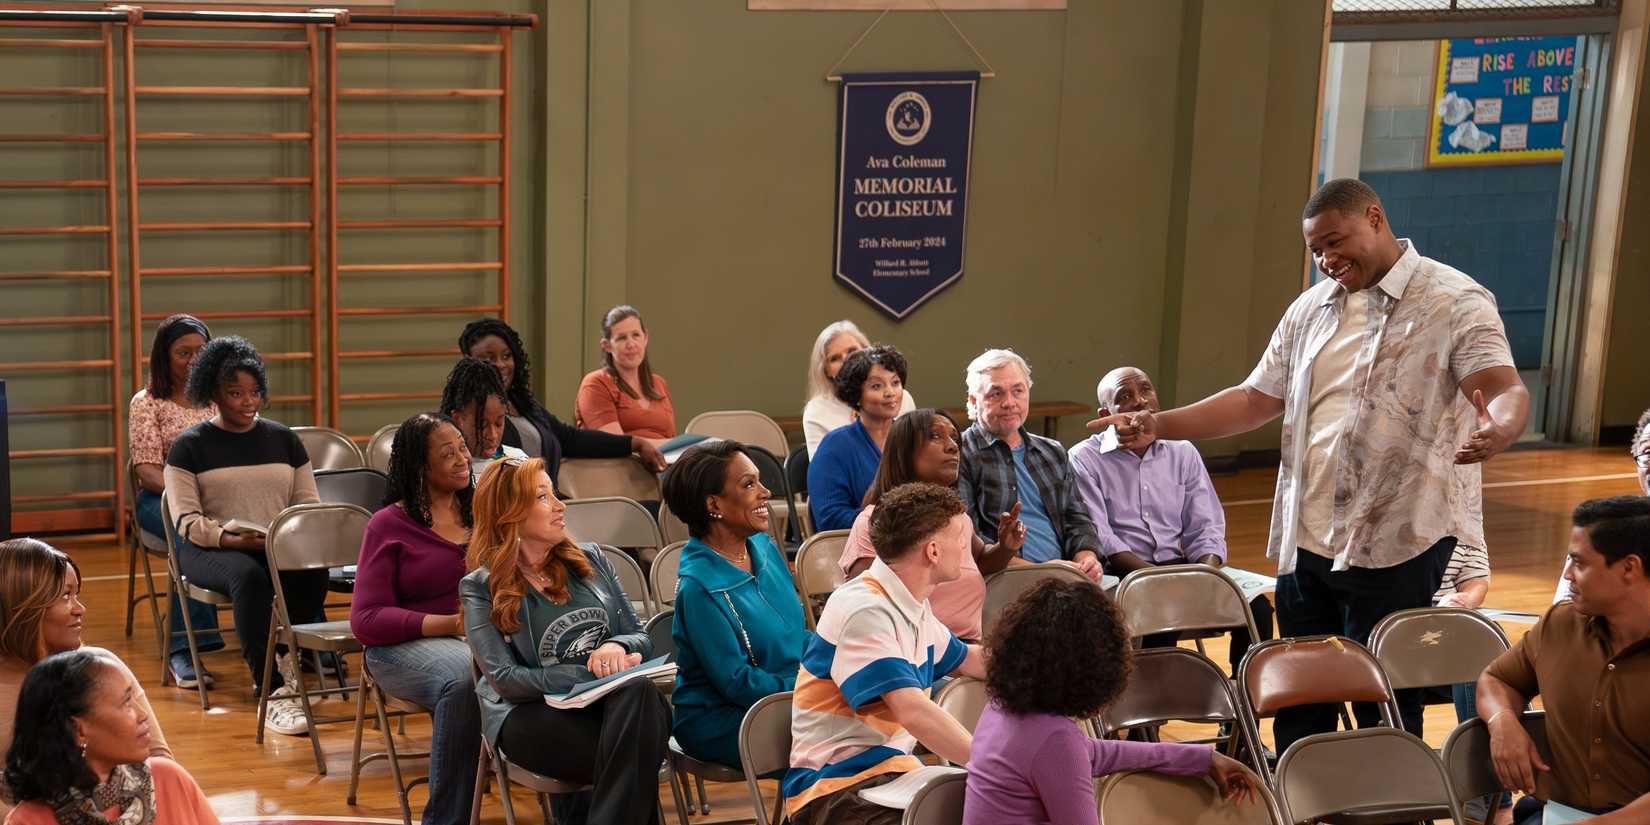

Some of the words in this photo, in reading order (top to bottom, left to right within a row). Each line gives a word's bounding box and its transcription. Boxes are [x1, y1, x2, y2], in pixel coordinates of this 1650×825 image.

[1482, 52, 1515, 72] RISE
[1526, 47, 1574, 68] ABOVE
[1503, 76, 1531, 96] THE
[866, 155, 889, 168] Ava
[892, 154, 946, 168] Coleman
[853, 177, 957, 194] MEMORIAL
[855, 200, 953, 218] COLISEUM
[858, 238, 879, 248] 27th
[880, 237, 922, 250] February
[923, 236, 946, 247] 2024
[542, 620, 569, 658] SUPER
